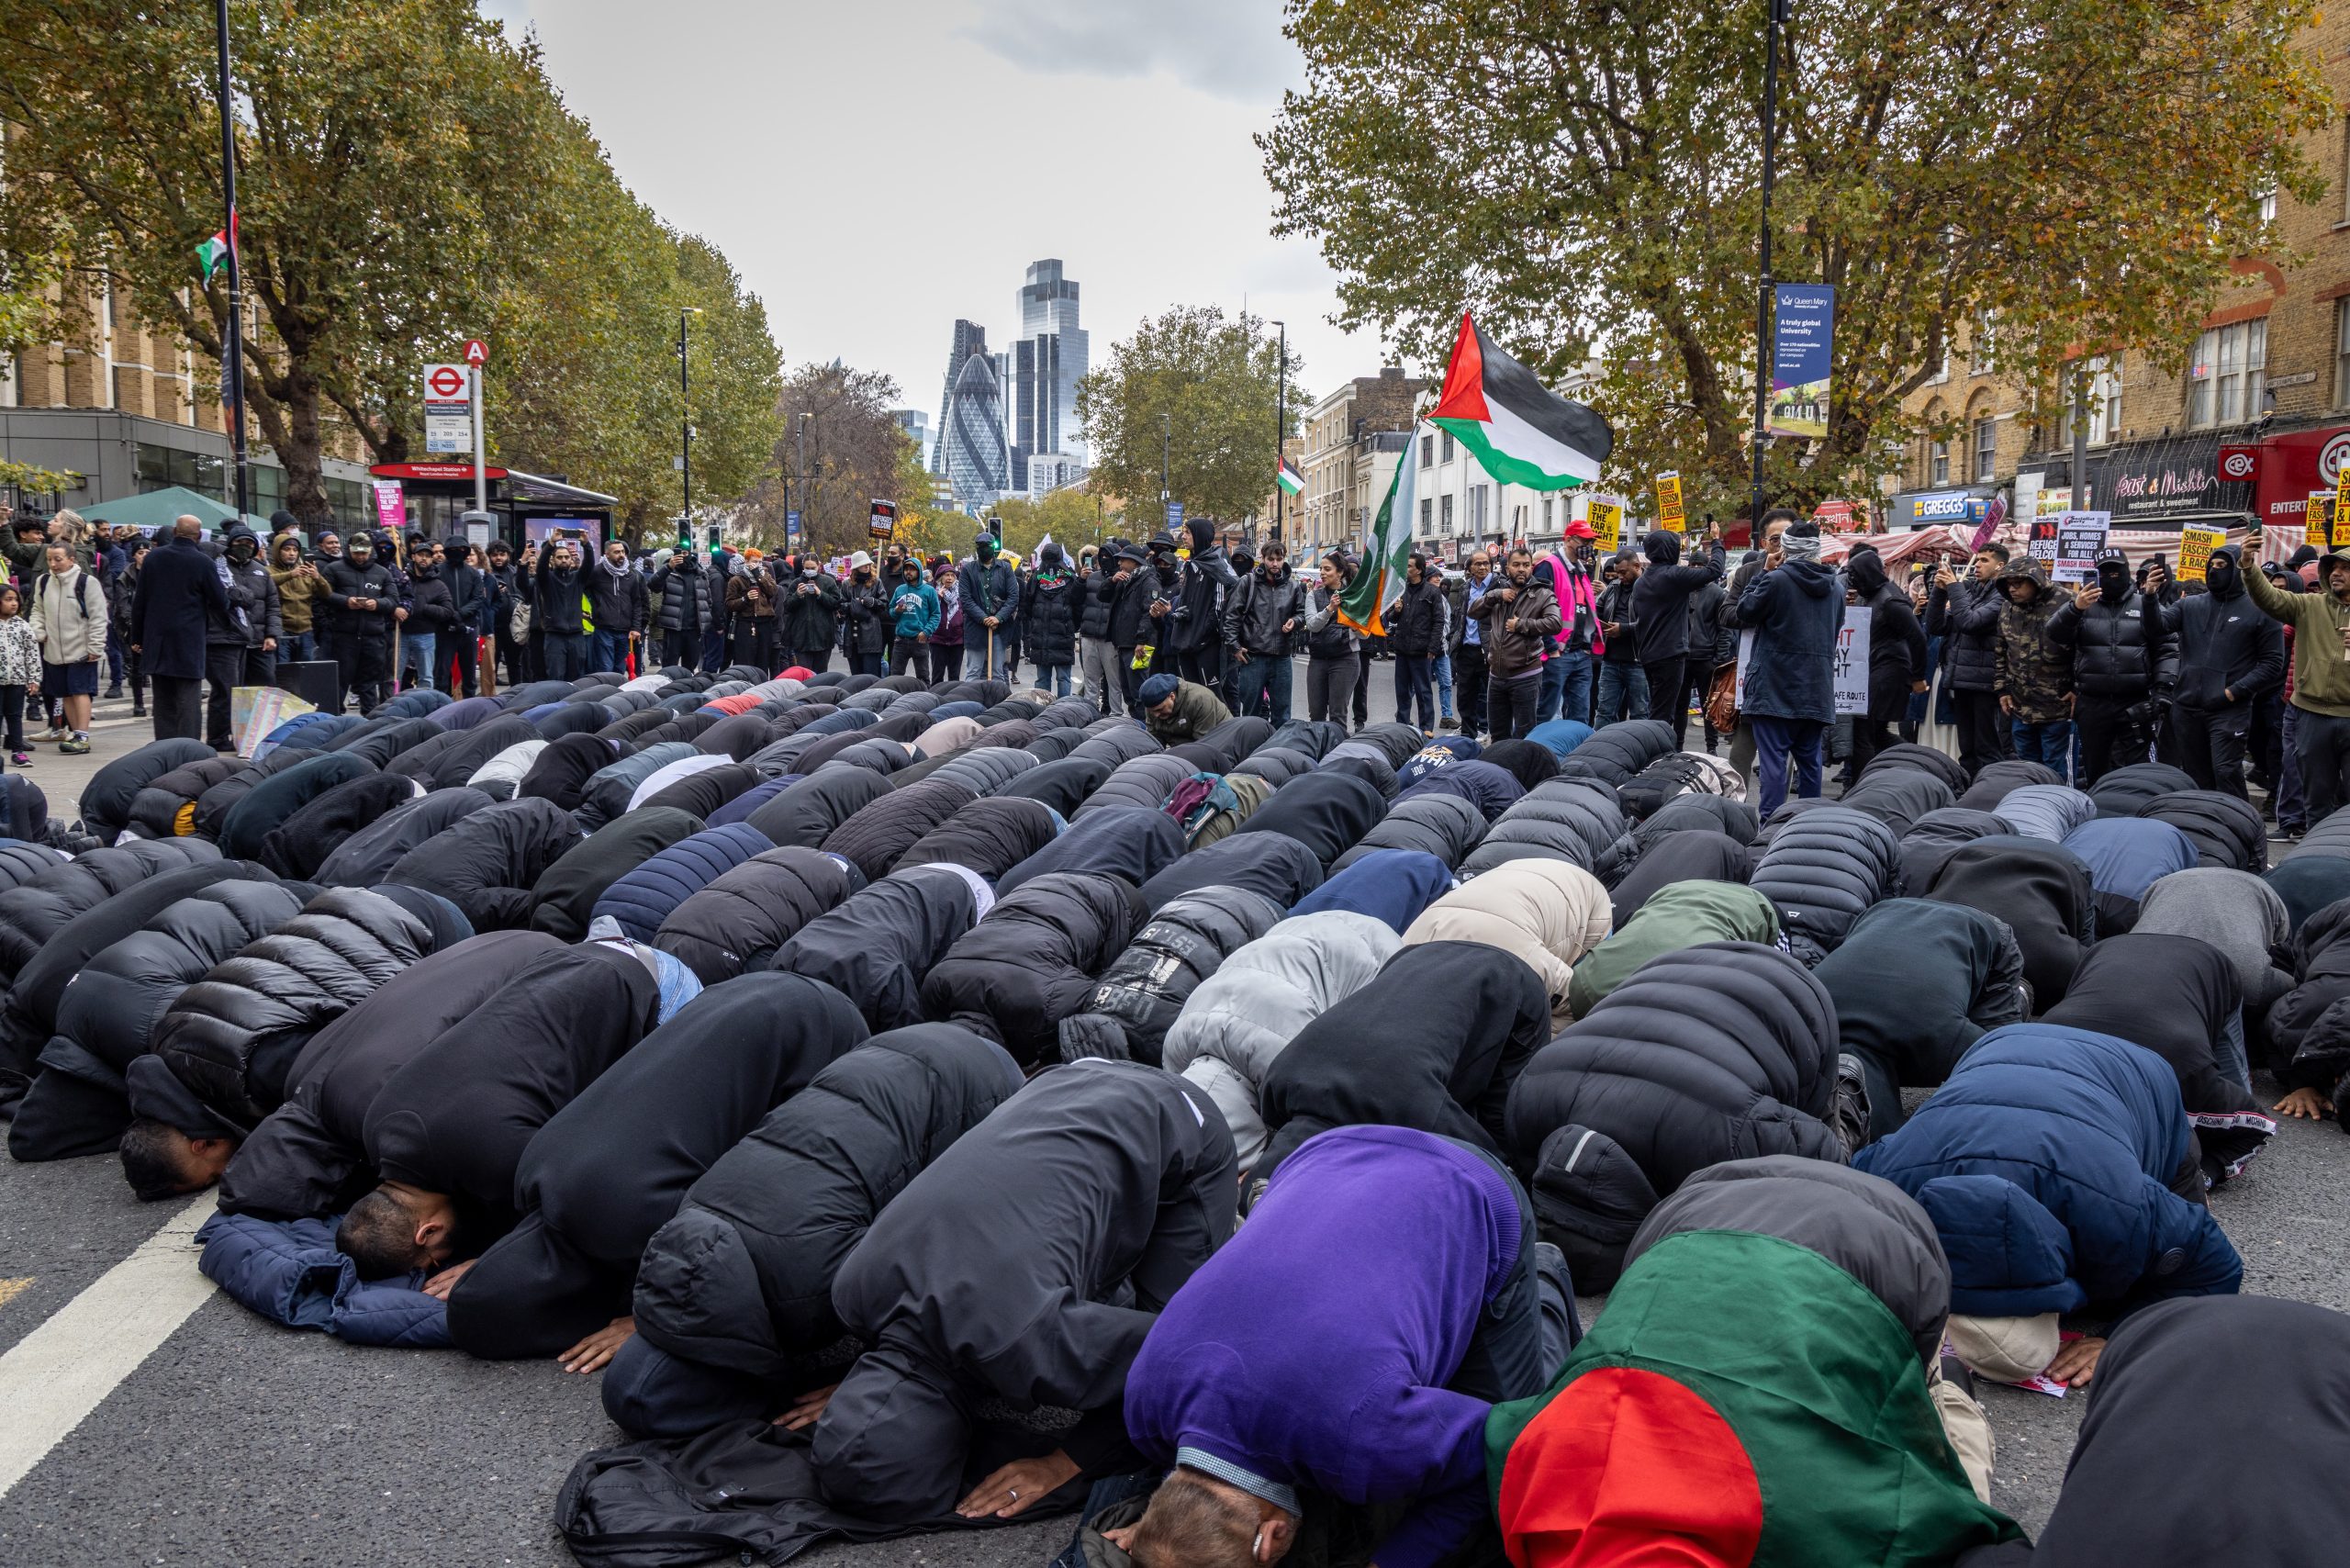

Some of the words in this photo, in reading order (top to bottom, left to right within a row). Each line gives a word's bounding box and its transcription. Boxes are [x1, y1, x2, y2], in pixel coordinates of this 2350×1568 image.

[1814, 298, 1828, 307] Mary
[1781, 328, 1812, 336] University
[467, 342, 485, 360] A
[1658, 480, 1674, 492] SMASH
[2161, 468, 2218, 496] Mishti
[1660, 493, 1679, 505] FASCISM
[2129, 500, 2158, 510] restaurant
[2160, 499, 2165, 508] &
[2166, 497, 2199, 507] sweetmeat
[1593, 504, 1614, 515] STOP
[1666, 506, 1683, 517] RACISM
[1924, 498, 1964, 515] GREGGS
[2270, 499, 2307, 514] ENTERT
[872, 514, 892, 524] REFUGEES
[1592, 512, 1606, 522] THE
[2309, 510, 2325, 520] FASC
[871, 521, 892, 530] WELCOME
[1591, 521, 1605, 531] FAR
[2062, 532, 2077, 541] JOBS,
[2079, 532, 2101, 541] HOMES
[2185, 532, 2212, 543] SMASH
[2030, 540, 2057, 551] REFUGE
[2070, 542, 2098, 550] SERVICES
[2029, 550, 2055, 561] WELCO
[2080, 551, 2093, 559] ALL!
[2095, 549, 2120, 563] ICON
[2057, 560, 2077, 568] SMASH
[2078, 560, 2096, 568] RACIS
[2180, 556, 2187, 566] &
[1835, 691, 1845, 700] AFE
[1846, 691, 1866, 700] ROUTE
[2197, 1115, 2224, 1126] OSCHINO
